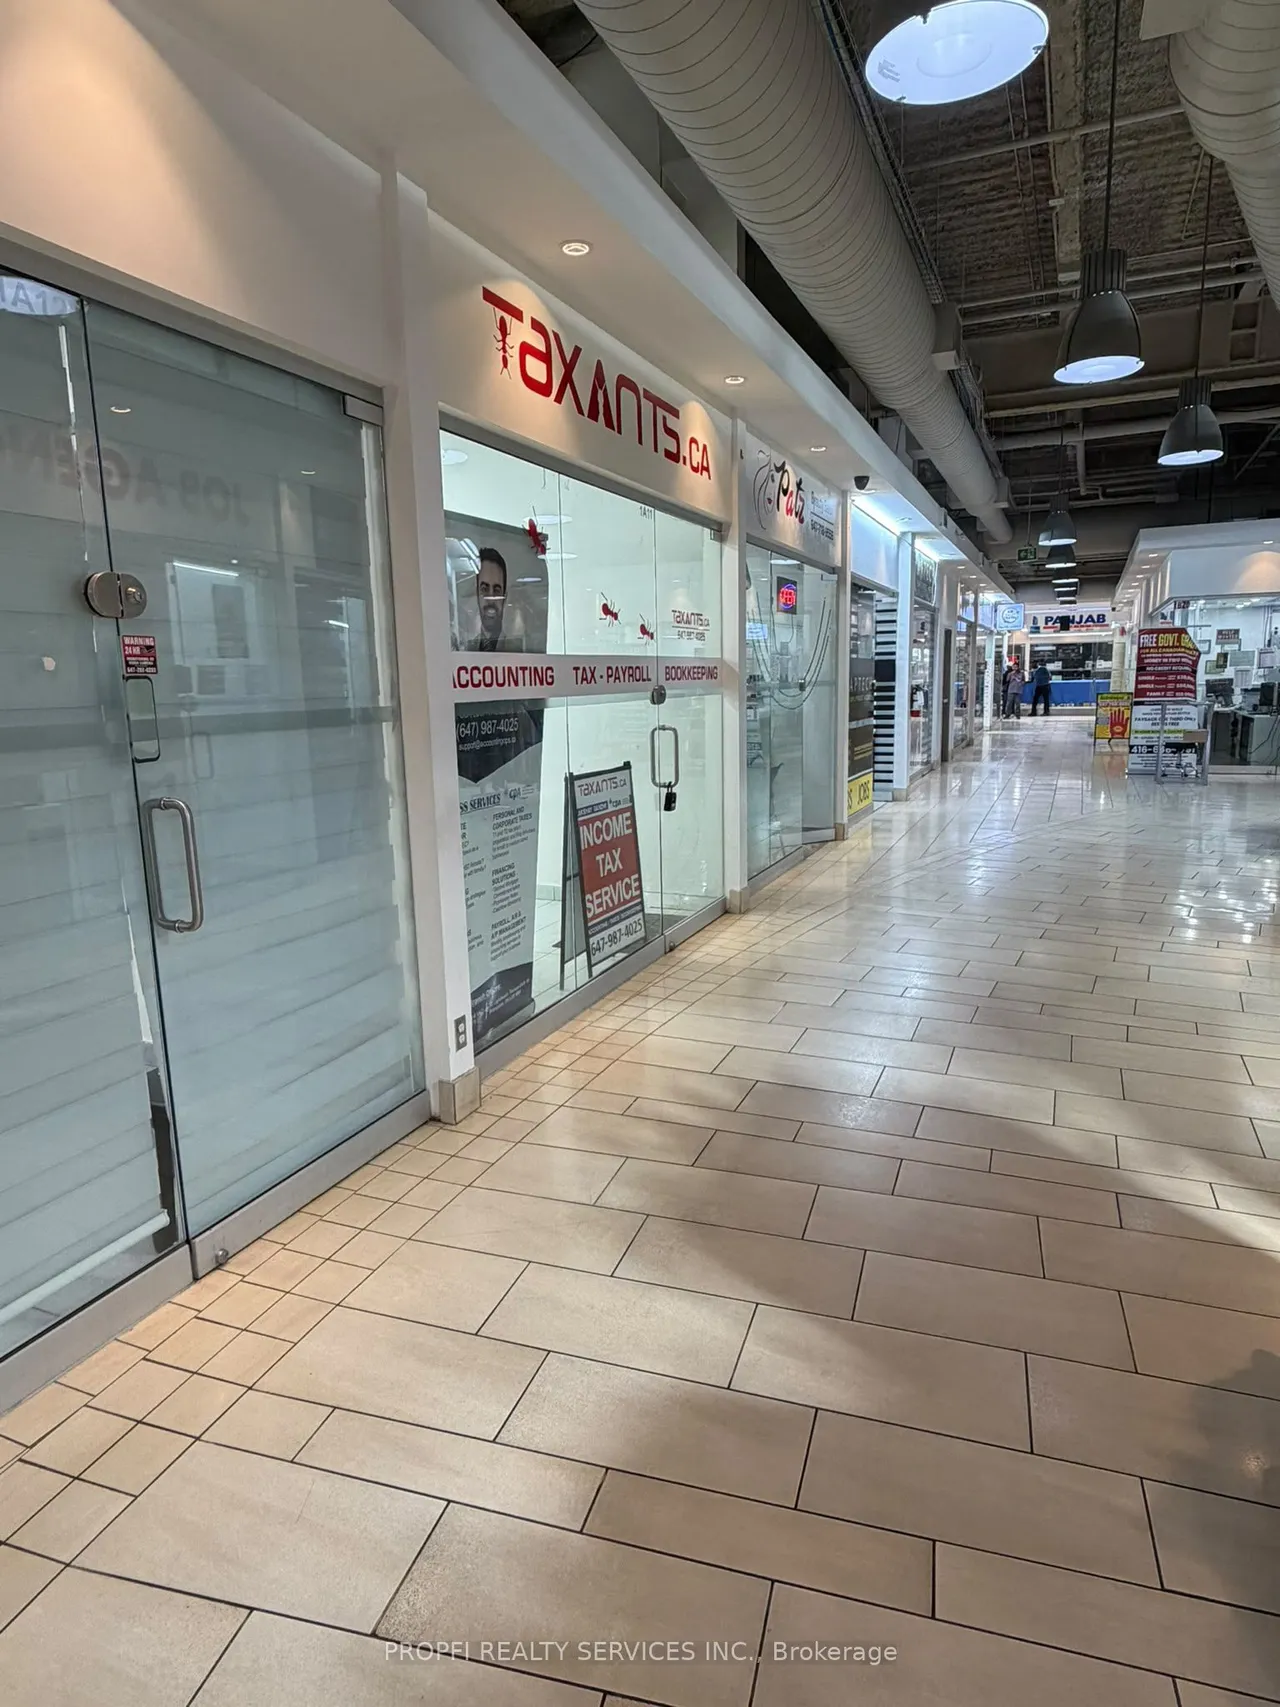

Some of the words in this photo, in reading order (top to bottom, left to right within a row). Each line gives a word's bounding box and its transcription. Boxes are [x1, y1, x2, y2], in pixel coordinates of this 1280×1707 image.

[123, 636, 155, 646] WARNING
[1140, 634, 1158, 647] FREE
[572, 666, 597, 685] TAX
[606, 666, 652, 684] PAYROLL
[664, 665, 718, 681] BOOKKEEPING
[456, 722, 479, 742] (647)
[480, 718, 519, 735] 987-4025
[469, 793, 501, 811] SERVICES
[580, 812, 632, 850] INCOME
[596, 848, 622, 877] TAX
[585, 874, 641, 919] SERVICE
[591, 918, 643, 956] 647-987-4025
